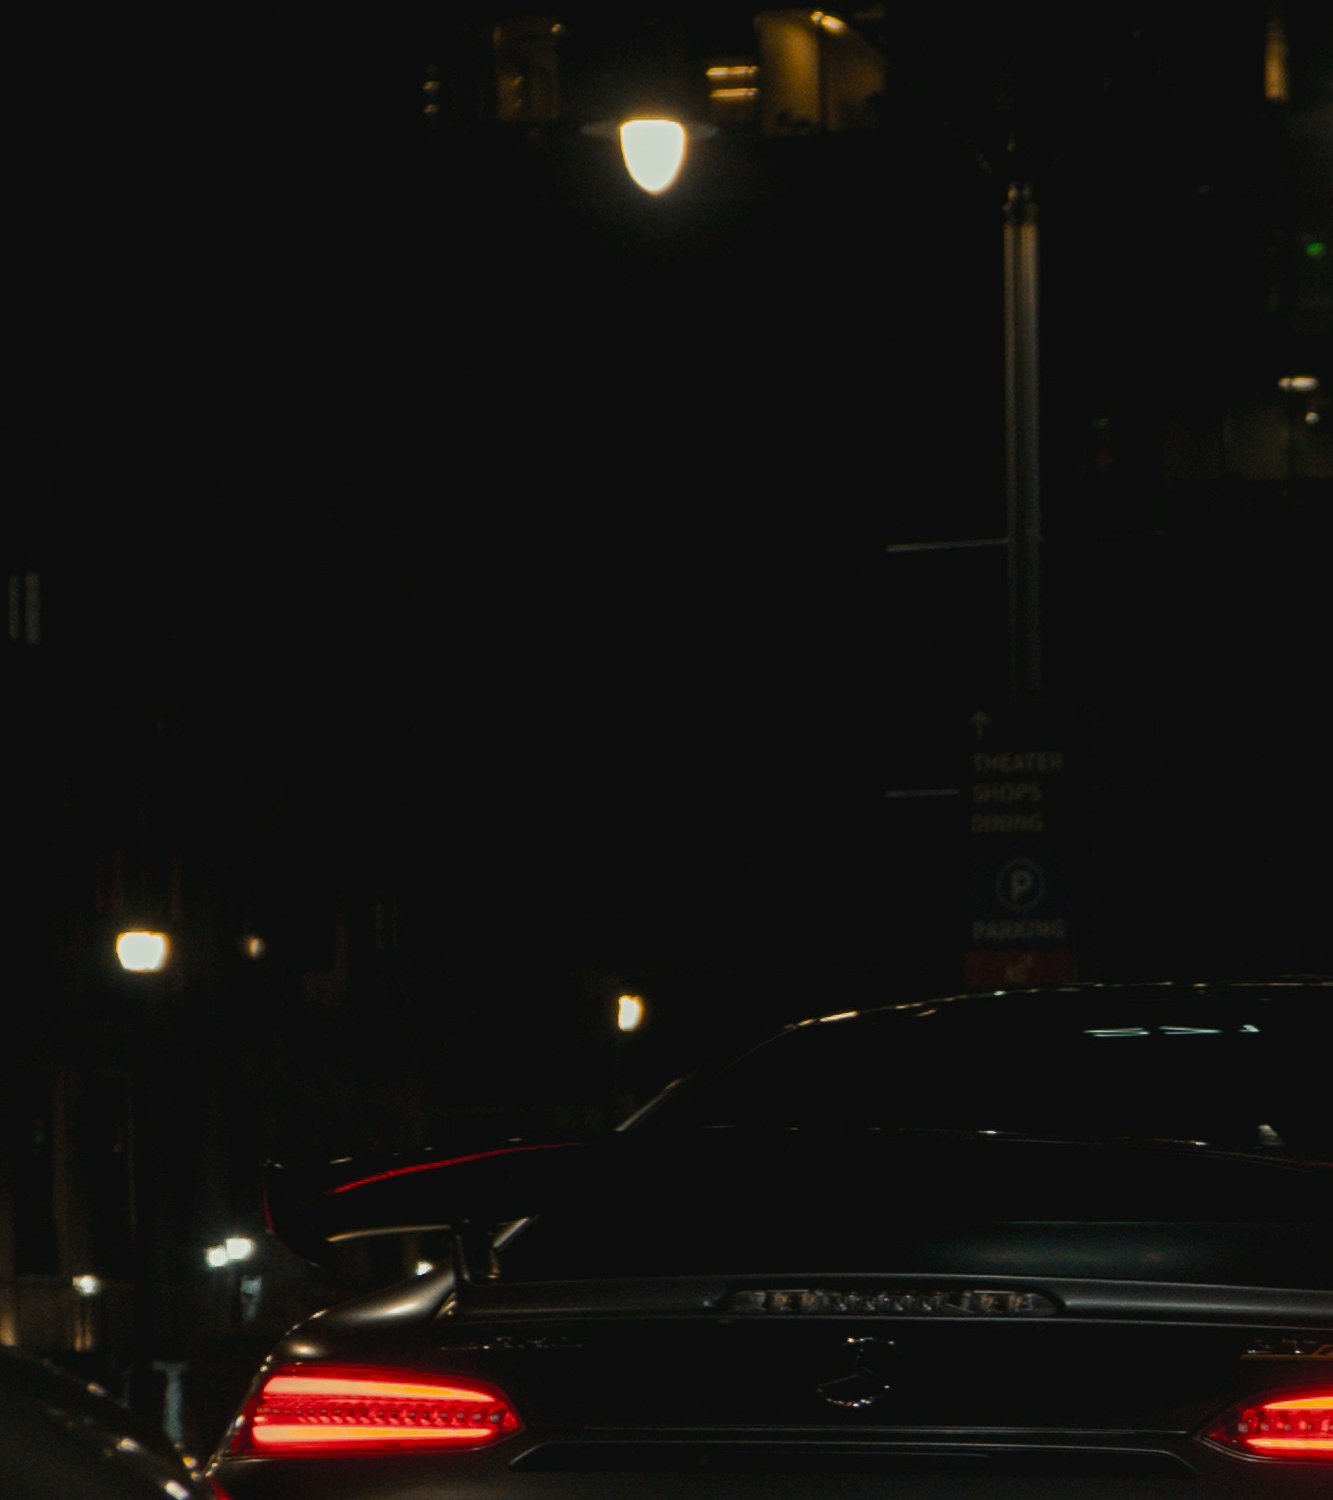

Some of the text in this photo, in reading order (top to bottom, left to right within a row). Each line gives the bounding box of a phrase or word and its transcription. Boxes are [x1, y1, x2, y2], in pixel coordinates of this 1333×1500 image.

[974, 751, 1064, 772] THEATER
[973, 782, 1042, 803] SHOPS
[971, 811, 1044, 833] DINING
[1010, 868, 1034, 902] P
[972, 919, 1067, 942] PARKING
